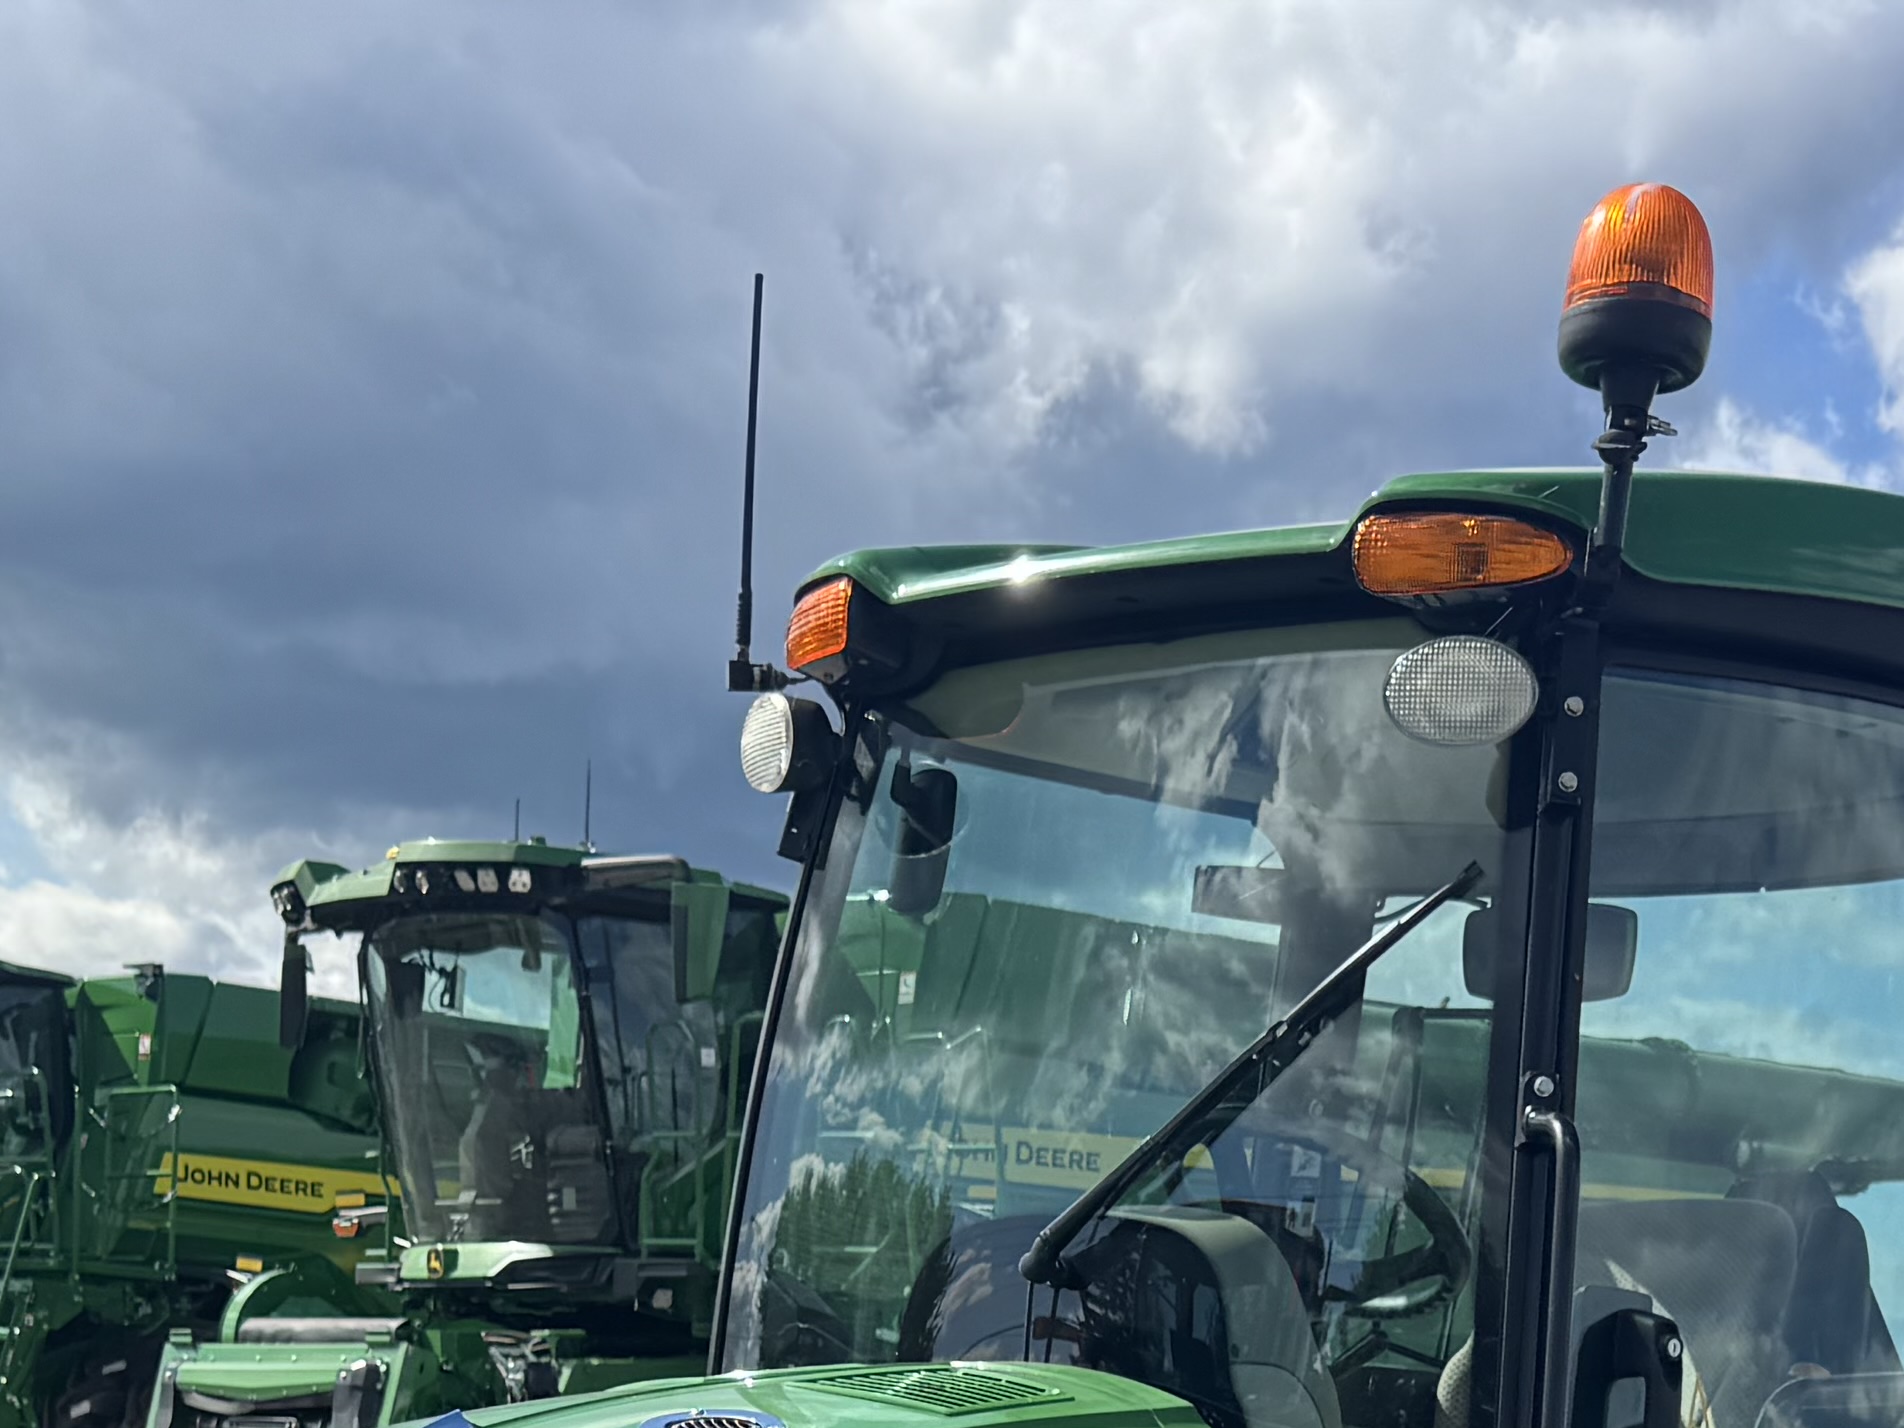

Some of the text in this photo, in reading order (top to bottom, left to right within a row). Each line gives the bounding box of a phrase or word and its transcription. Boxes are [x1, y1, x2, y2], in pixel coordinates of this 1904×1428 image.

[1016, 1141, 1101, 1172] DEERE
[177, 1163, 324, 1198] JOHN DEERE
